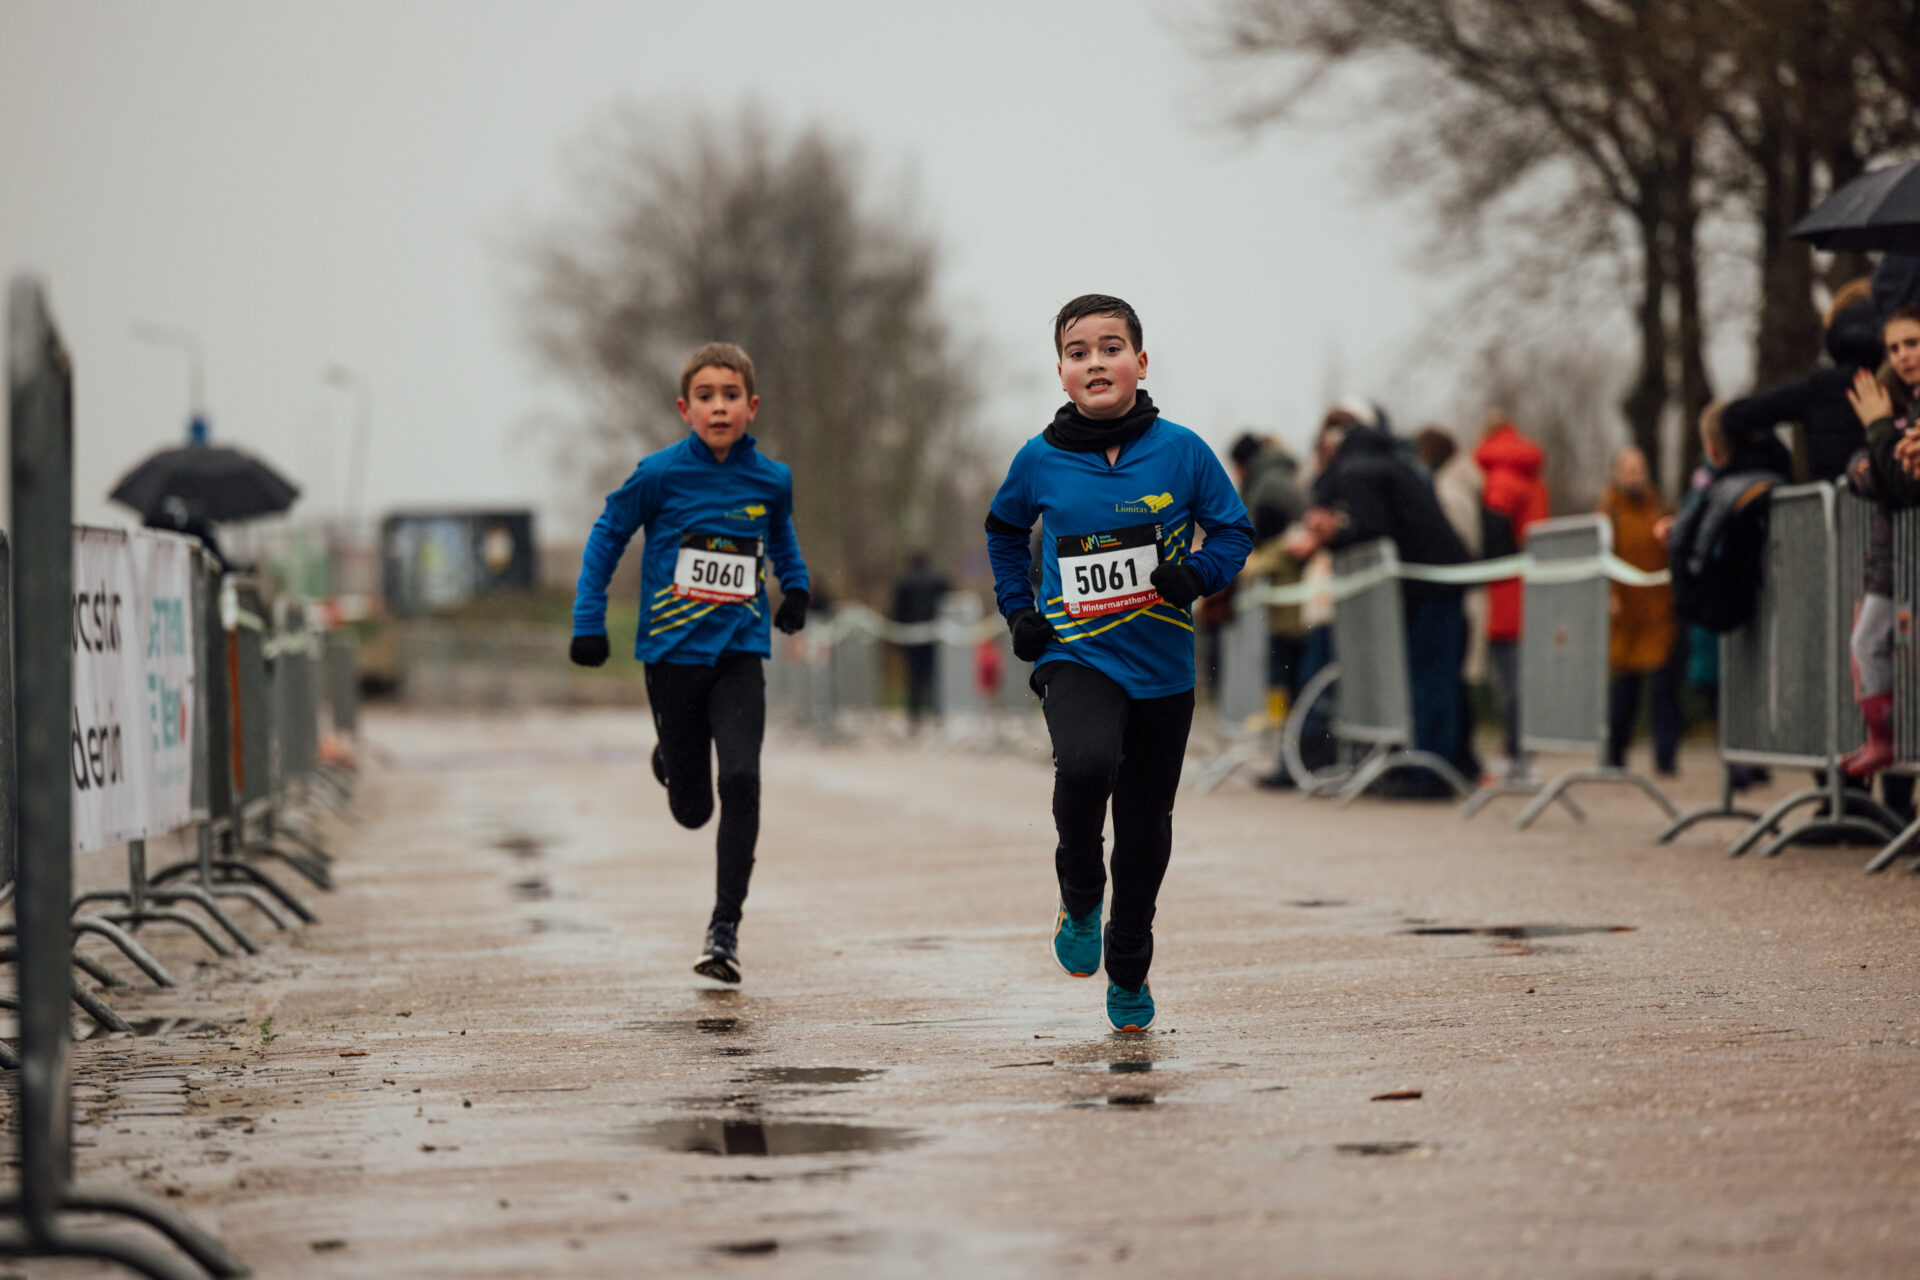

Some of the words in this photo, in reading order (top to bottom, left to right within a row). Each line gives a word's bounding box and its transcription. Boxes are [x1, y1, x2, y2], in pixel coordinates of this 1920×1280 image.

[1115, 504, 1148, 513] Lionitas
[691, 559, 745, 588] 5060
[1075, 558, 1138, 596] 5061
